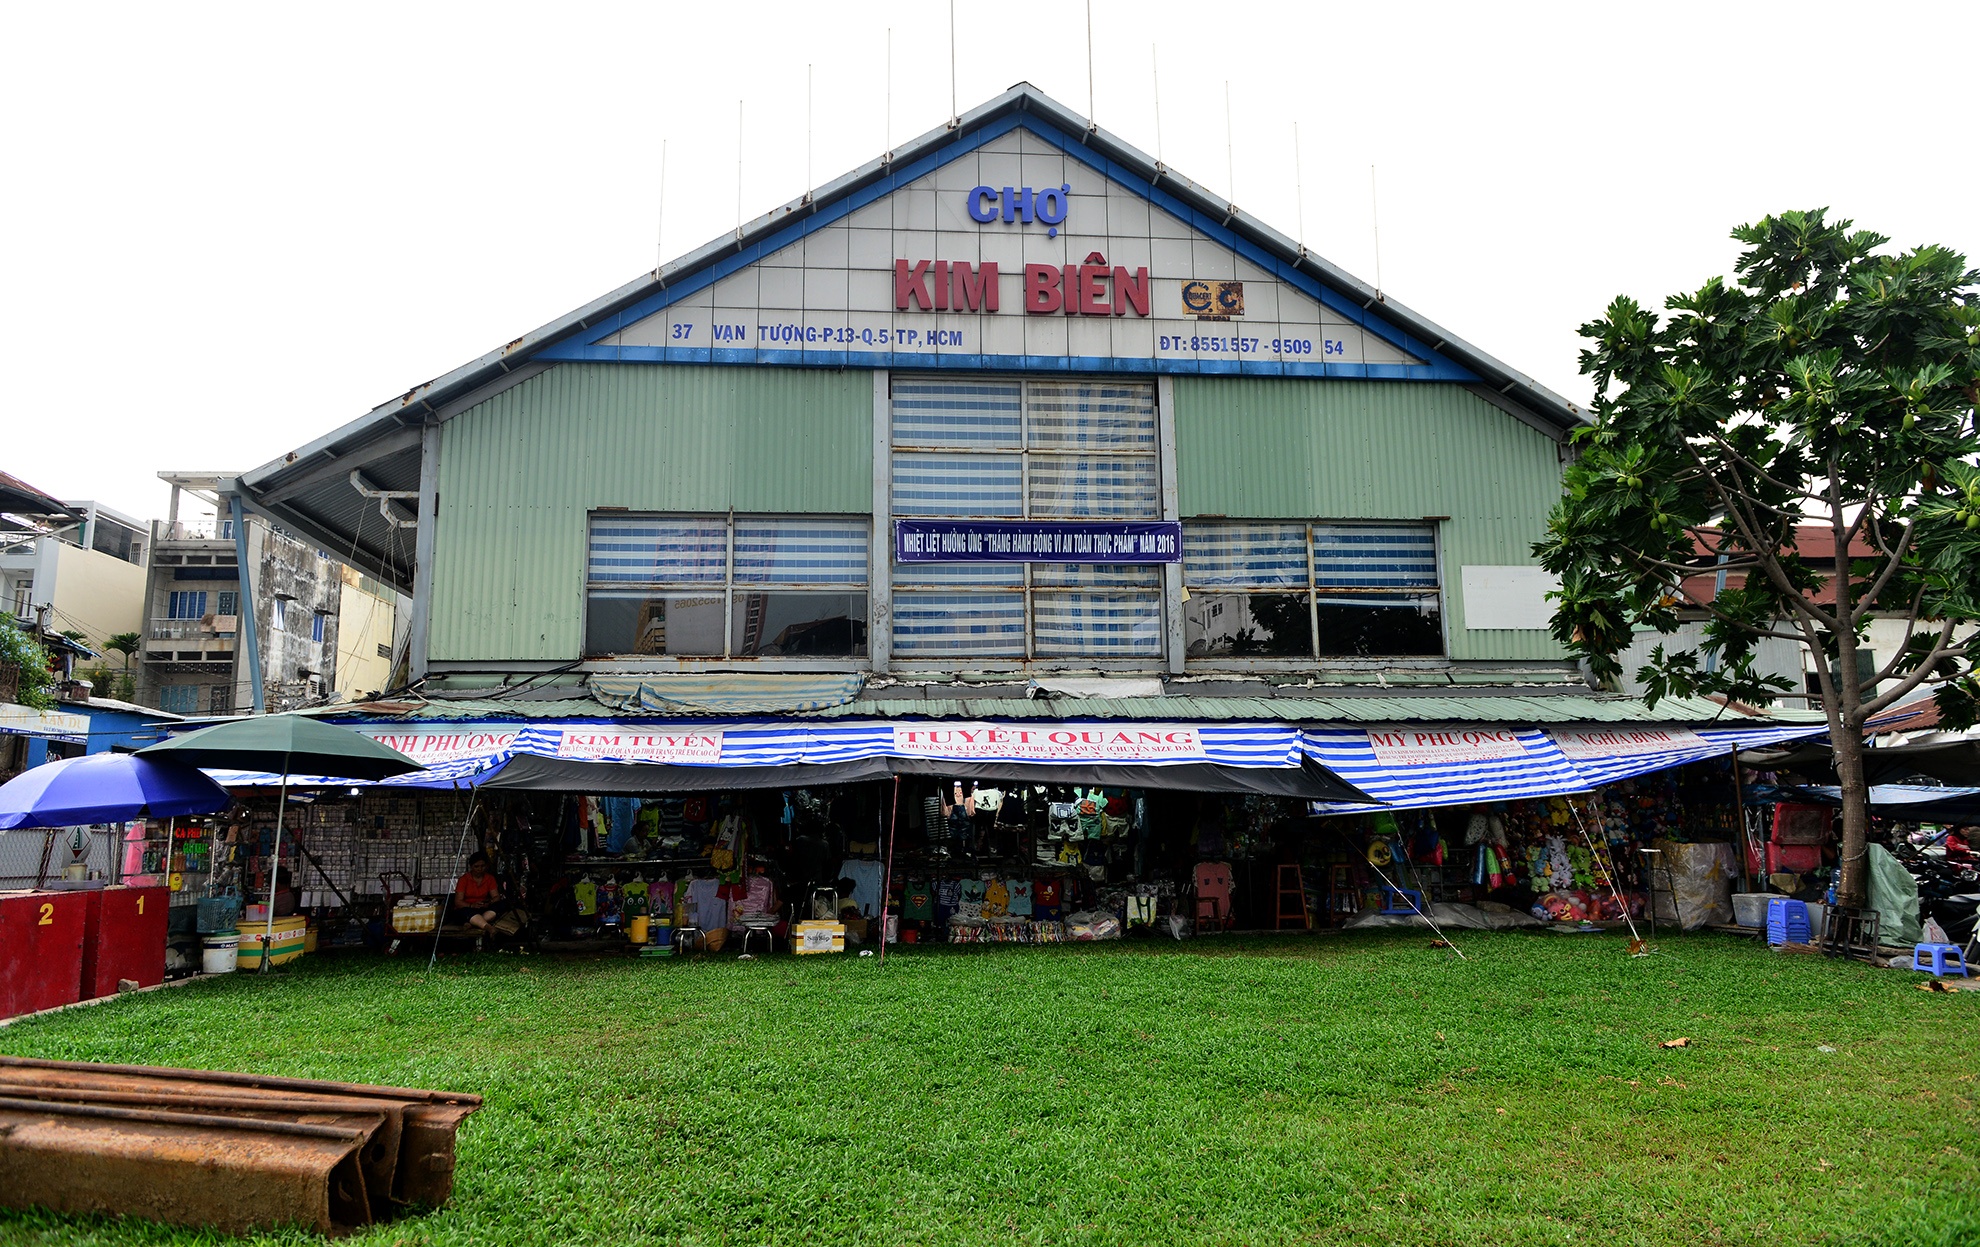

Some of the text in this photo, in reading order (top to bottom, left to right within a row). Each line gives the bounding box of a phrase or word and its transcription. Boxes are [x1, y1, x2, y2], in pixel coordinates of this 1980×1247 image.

[967, 184, 1071, 239] CHỢ
[895, 252, 1149, 317] KIM BIÊN
[672, 323, 693, 339] 37
[713, 324, 746, 343] VẠN
[904, 529, 924, 556] NHIỆT
[926, 529, 940, 556] LIỆT
[942, 527, 966, 553] HƯỞNG
[967, 527, 982, 553] ỨNG
[1012, 529, 1032, 553] HÀNH
[1033, 529, 1052, 557] ĐỘNG
[1054, 529, 1062, 553] VÌ
[1062, 533, 1073, 553] AN
[1074, 529, 1092, 553] TOÀN
[1093, 532, 1112, 557] THỰC
[1139, 530, 1156, 553] NĂM
[1157, 533, 1175, 553] 2016
[422, 731, 515, 752] PHƯƠNG
[568, 732, 717, 747] KIM TUYẾN
[900, 726, 1193, 746] TUYẾT QUANG
[1371, 729, 1515, 747] MỸ PHƯỢNG
[1576, 728, 1671, 746] NGHĨA BÌNH
[38, 903, 54, 926] 2
[136, 895, 145, 915] 1
